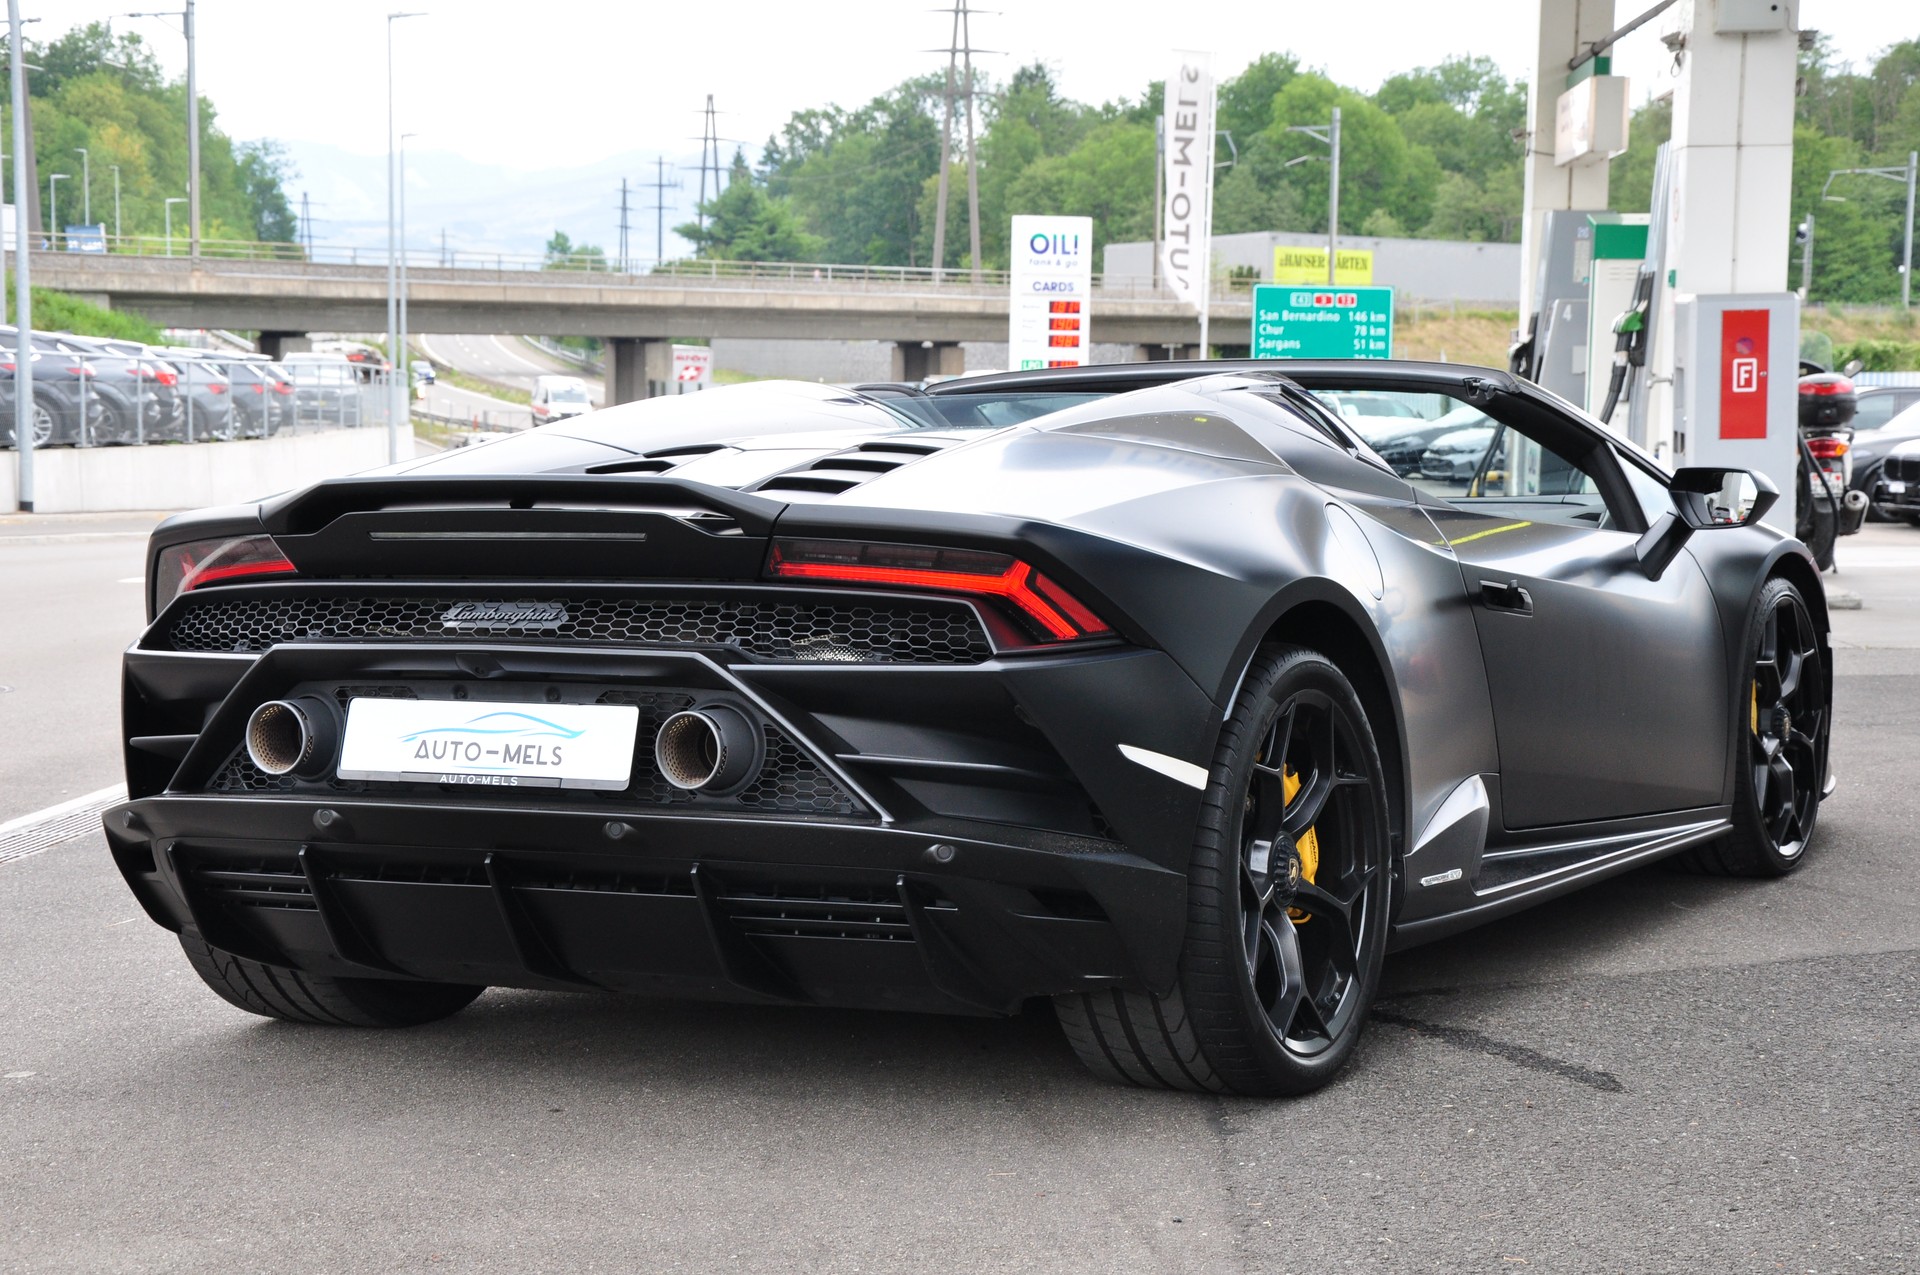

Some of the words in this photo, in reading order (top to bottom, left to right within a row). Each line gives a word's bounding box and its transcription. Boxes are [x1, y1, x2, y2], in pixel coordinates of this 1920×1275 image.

[1030, 233, 1078, 255] OIL!
[1334, 252, 1369, 271] ÄRTEN
[1032, 281, 1074, 292] CARDS
[1259, 309, 1279, 321] San
[1282, 310, 1340, 322] Bernardino
[1349, 311, 1368, 322] 146
[1370, 311, 1387, 322] km
[1563, 304, 1572, 321] 4
[1259, 323, 1284, 335] Chur
[1354, 325, 1367, 336] 78
[1370, 325, 1386, 336] km
[1259, 337, 1301, 351] Sargans
[1353, 338, 1366, 350] 51
[1369, 338, 1386, 350] km
[1740, 366, 1752, 386] F
[441, 603, 562, 625] Lamborghini
[414, 740, 562, 766] AUTO-MELS
[439, 774, 518, 786] AUTO-MELS
